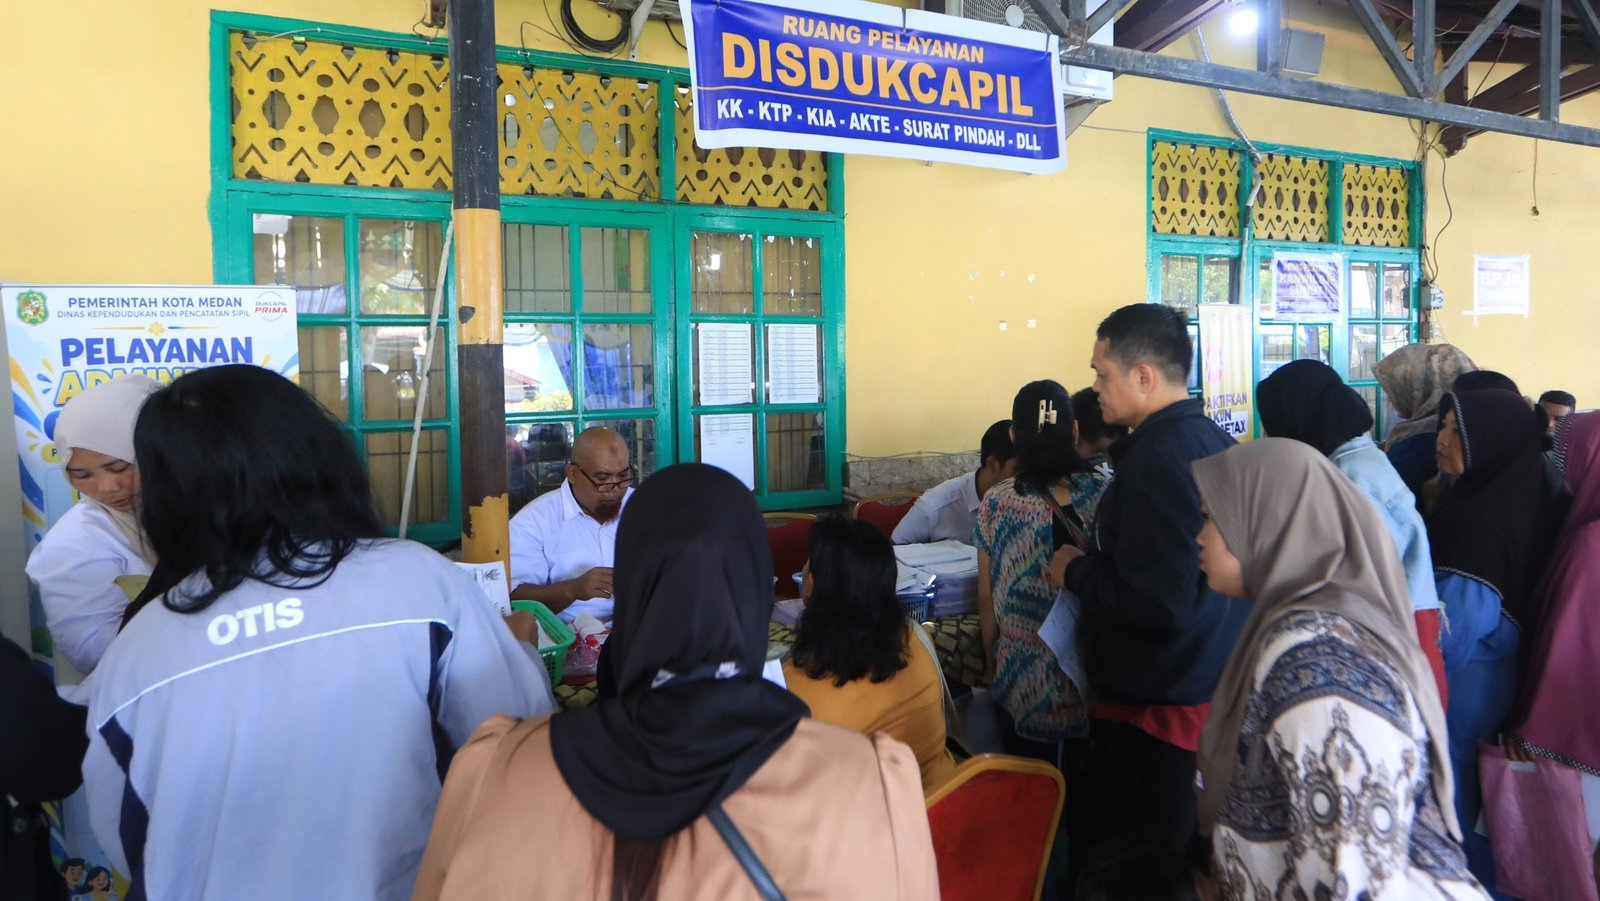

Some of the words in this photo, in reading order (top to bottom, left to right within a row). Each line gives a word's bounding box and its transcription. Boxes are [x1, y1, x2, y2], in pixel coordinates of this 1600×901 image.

[783, 15, 861, 44] RUANG
[868, 28, 984, 64] PELAYANAN
[722, 32, 1033, 117] DISDUKCAPIL
[717, 98, 744, 119] KK
[758, 101, 792, 122] KTP
[806, 107, 836, 128] KIA
[850, 112, 891, 133] AKTE
[903, 118, 950, 140] SURAT
[954, 124, 1005, 147] PINDAH
[1016, 132, 1041, 151] DLL
[57, 310, 85, 318] DINAS
[87, 310, 157, 318] KEPENDUDUKAN
[160, 310, 177, 318] DAN
[231, 309, 251, 317] SIPIL
[68, 297, 158, 308] PEMERINTAH
[162, 297, 194, 308] KOTA
[198, 297, 242, 308] MEDAN
[255, 306, 288, 314] PRIMA
[60, 336, 253, 367] PELAYANAN
[1207, 392, 1248, 409] AKTIFKAN
[207, 597, 305, 646] OTIS
